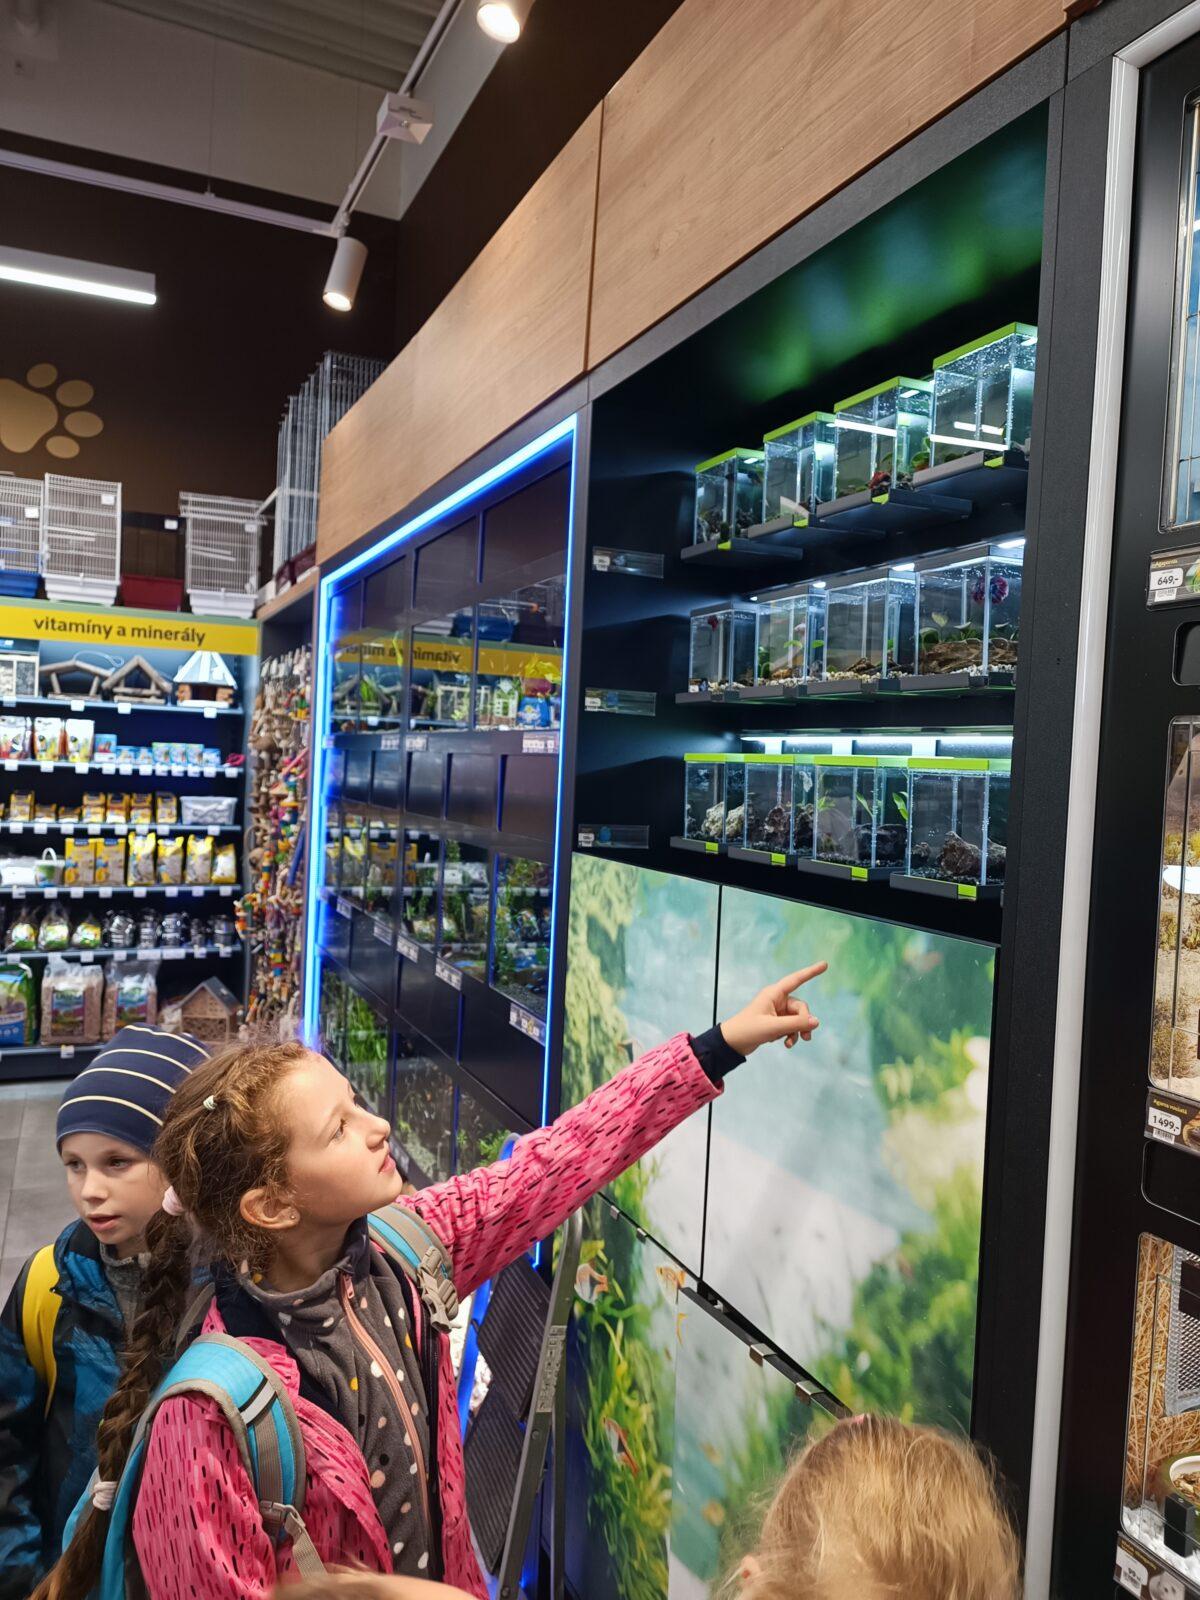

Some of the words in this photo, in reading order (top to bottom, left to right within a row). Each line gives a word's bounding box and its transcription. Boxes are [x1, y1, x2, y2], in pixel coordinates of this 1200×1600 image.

[1157, 575, 1179, 586] 649,-
[34, 615, 113, 640] vitamíny
[117, 625, 127, 638] a
[131, 626, 206, 646] minerály
